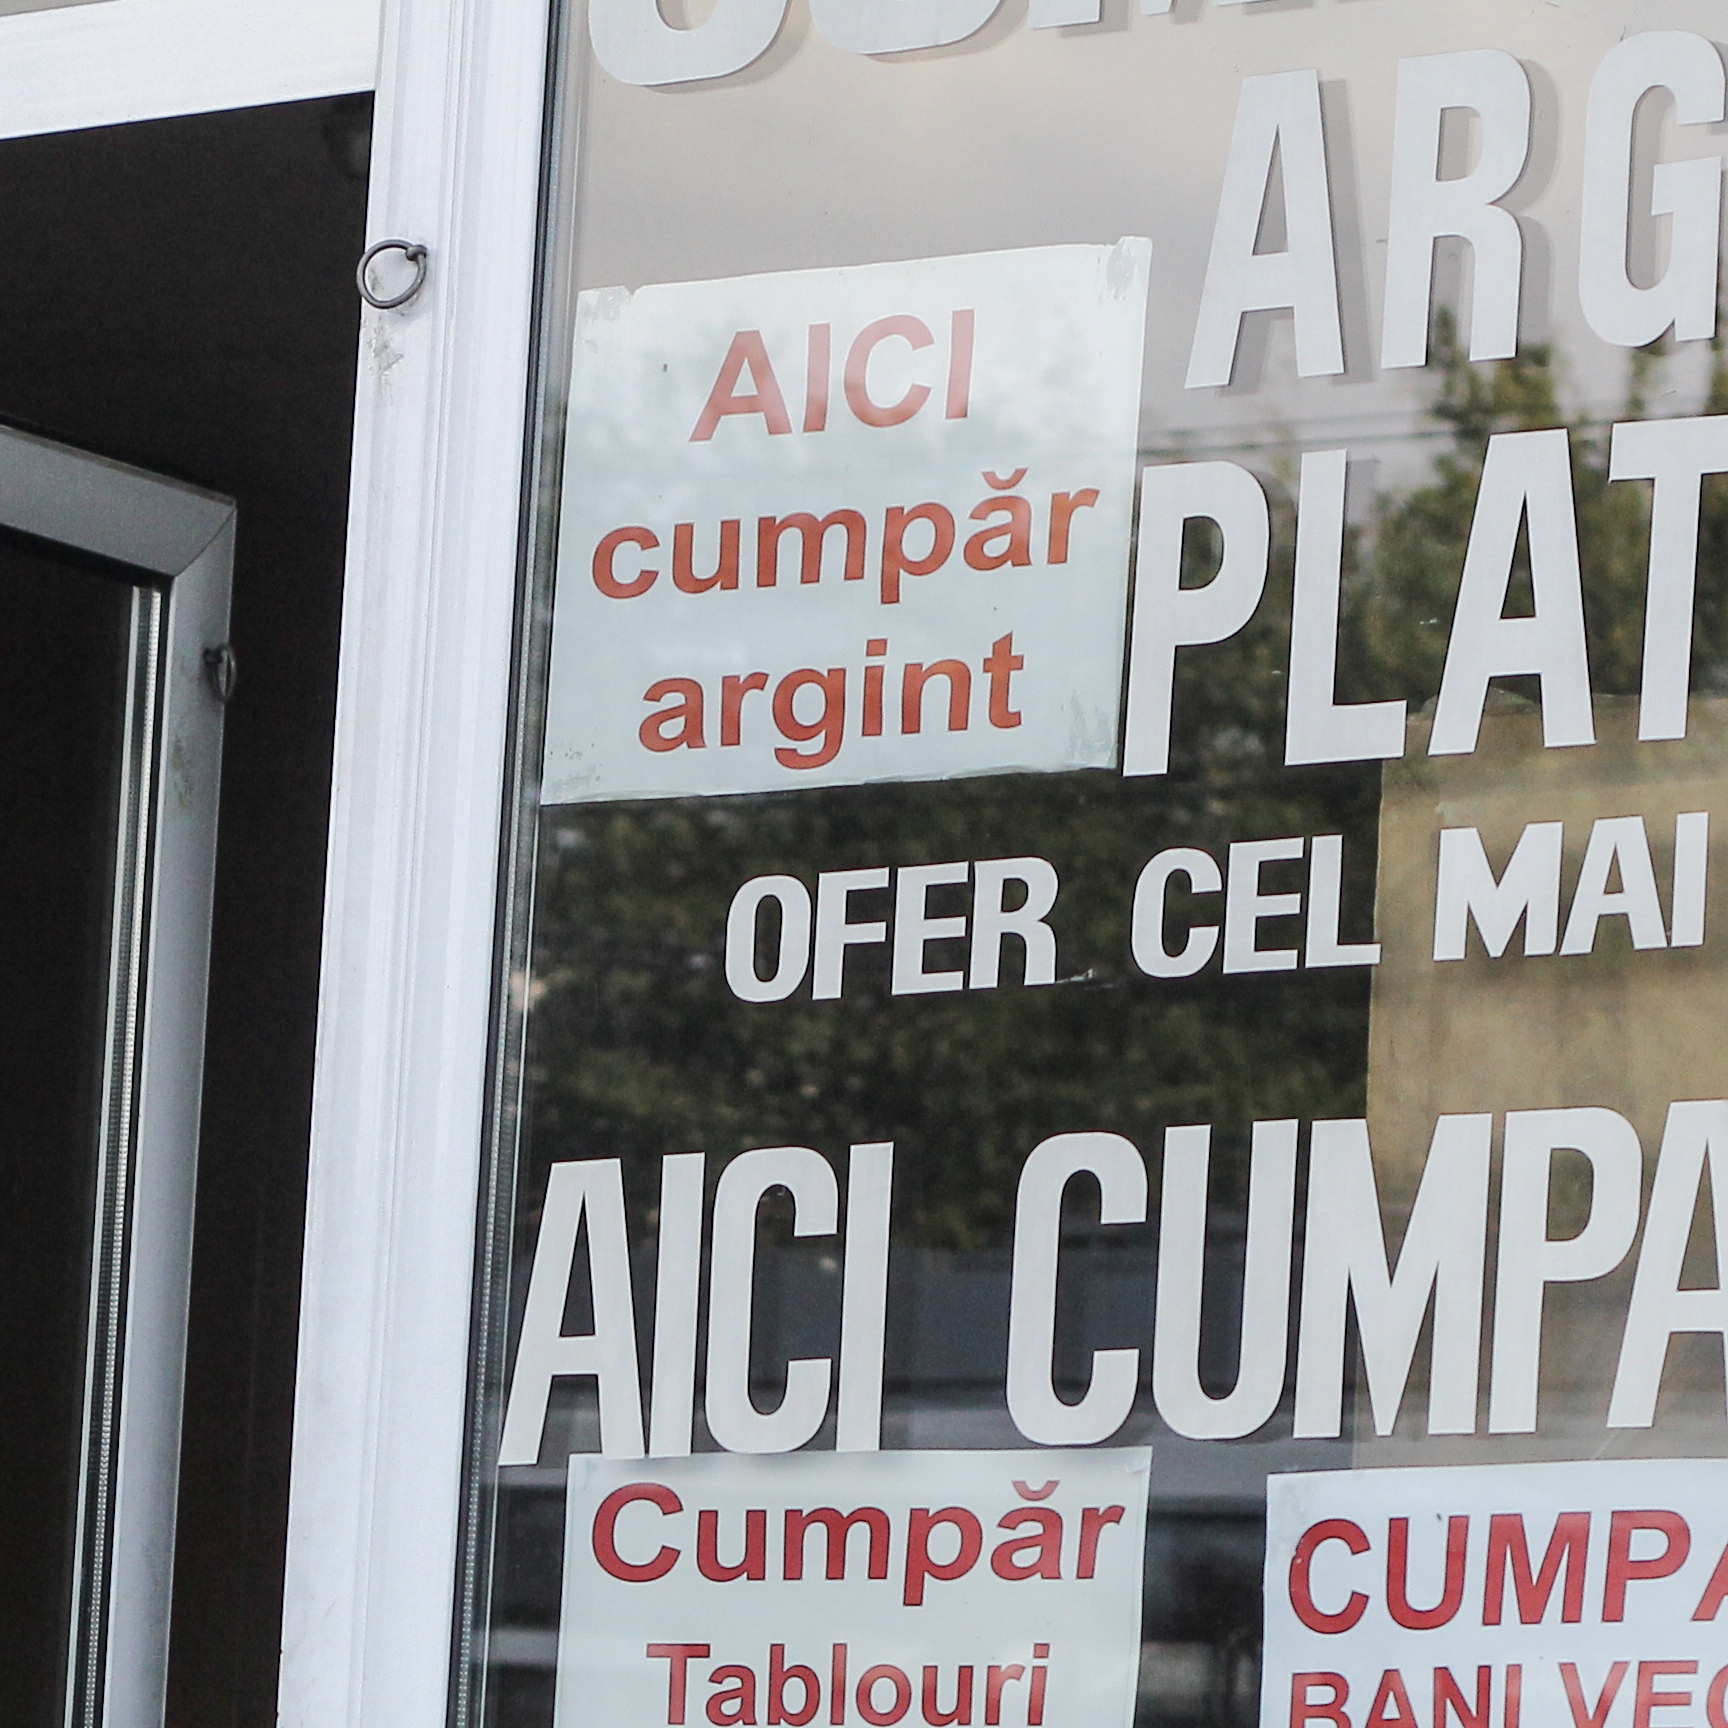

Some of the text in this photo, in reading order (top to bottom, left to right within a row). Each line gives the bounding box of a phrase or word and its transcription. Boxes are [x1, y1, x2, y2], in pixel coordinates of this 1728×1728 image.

[689, 308, 976, 443] AICI
[591, 467, 1100, 606] cumpăr
[638, 631, 1025, 770] argint
[724, 855, 1060, 1003] OFER
[1131, 834, 1381, 979] CEL
[1433, 812, 1709, 963] MAI
[498, 1141, 895, 1467] AICI
[592, 1479, 1125, 1607] Cumpăr
[647, 1643, 1050, 1727] Tablouri
